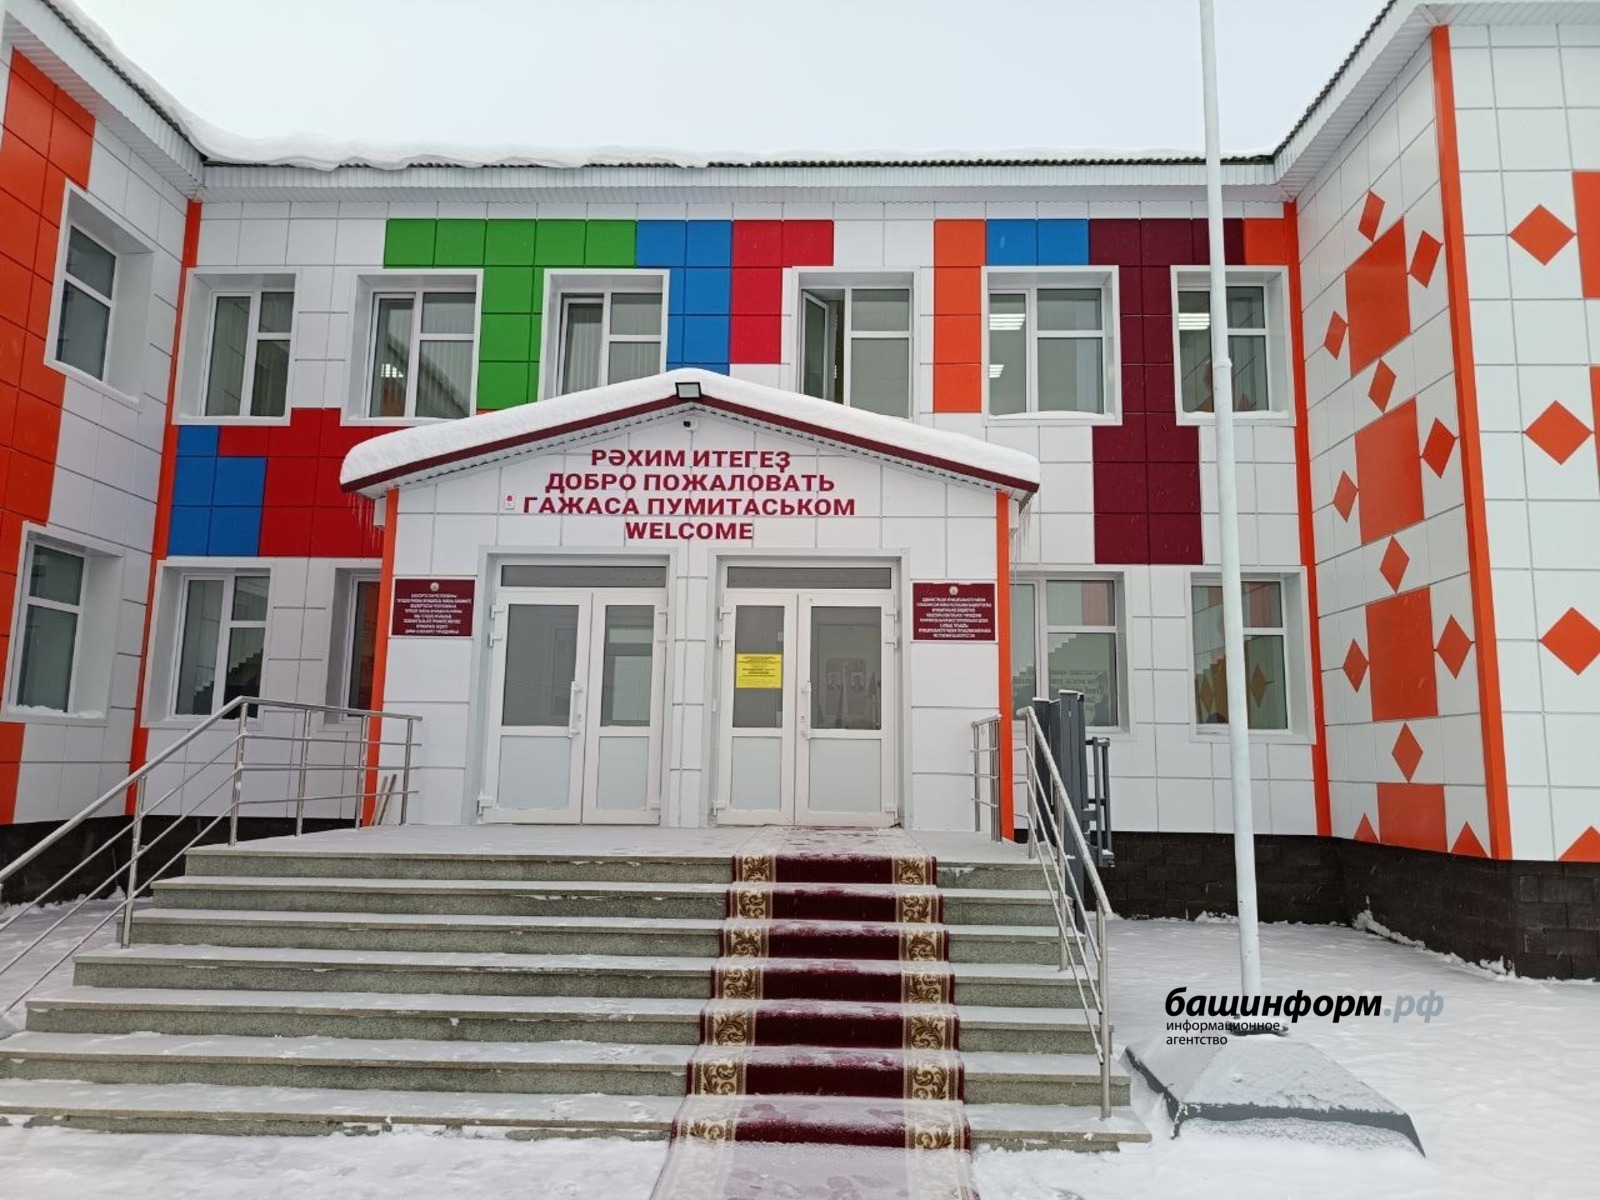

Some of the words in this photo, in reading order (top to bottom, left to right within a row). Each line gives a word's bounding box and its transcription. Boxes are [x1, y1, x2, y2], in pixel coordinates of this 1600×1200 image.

[592, 449, 686, 468] РӘХИМ
[545, 473, 637, 493] ДОБРО
[644, 474, 835, 492] ПОЖАЛОВАТЬ
[524, 496, 639, 515] ГАЖАСА
[648, 498, 855, 516] ПУМИТАСЬКОМ
[625, 522, 753, 540] WELCOME
